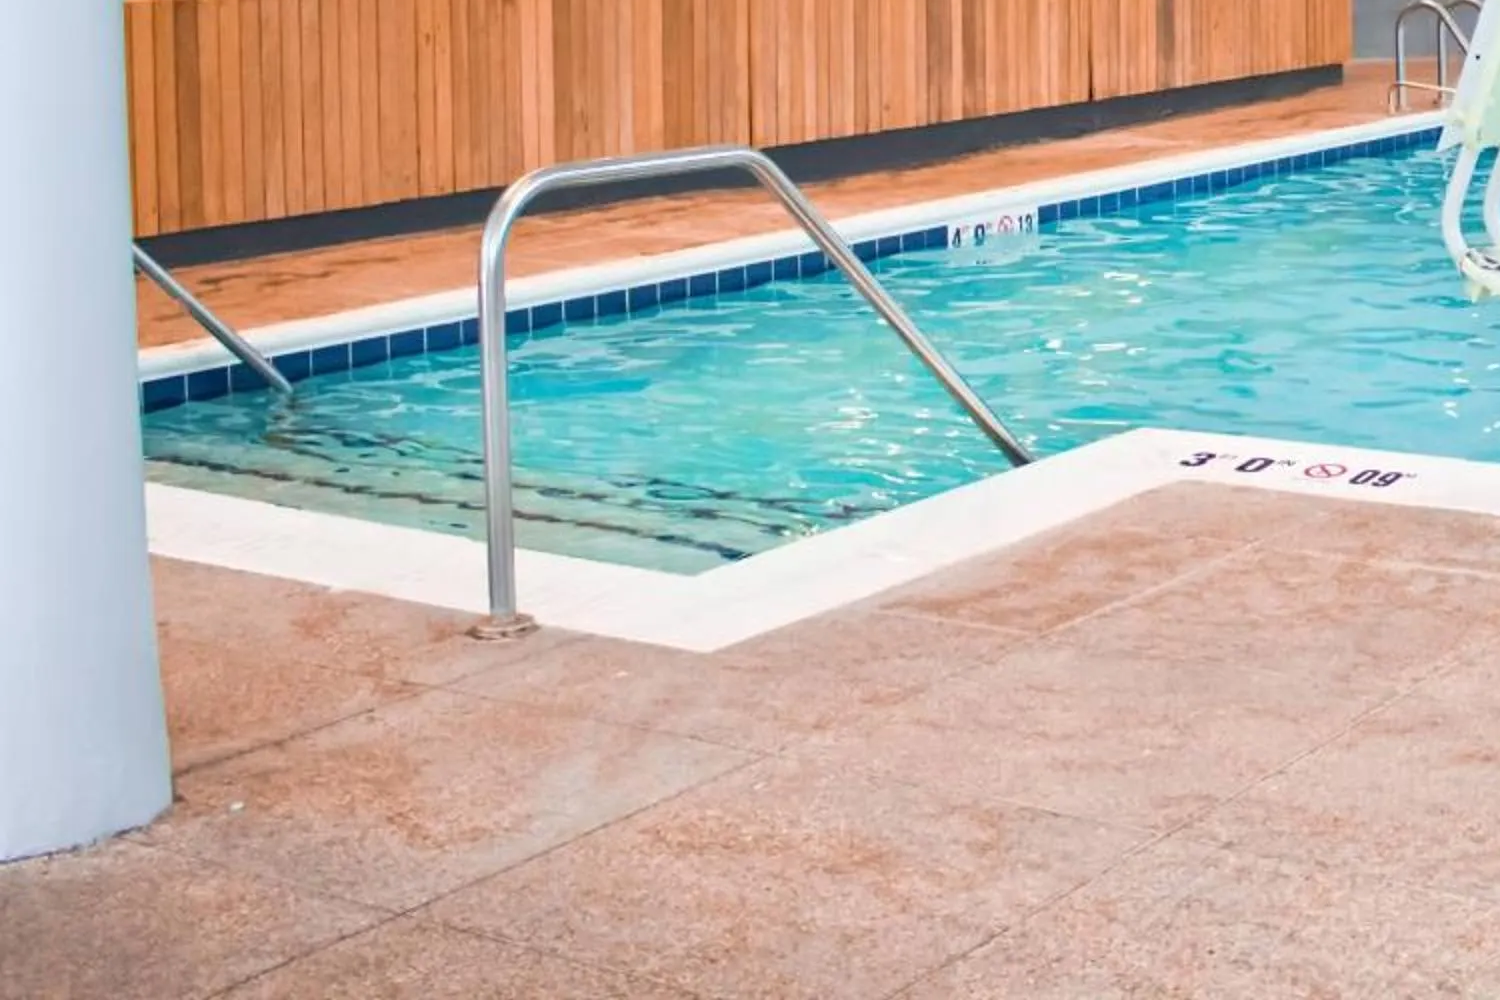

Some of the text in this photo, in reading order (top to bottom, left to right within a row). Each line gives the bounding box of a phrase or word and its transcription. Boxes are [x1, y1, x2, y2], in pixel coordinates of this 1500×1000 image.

[1179, 452, 1217, 467] 3
[1234, 457, 1275, 473] 0
[1348, 469, 1403, 487] 09
